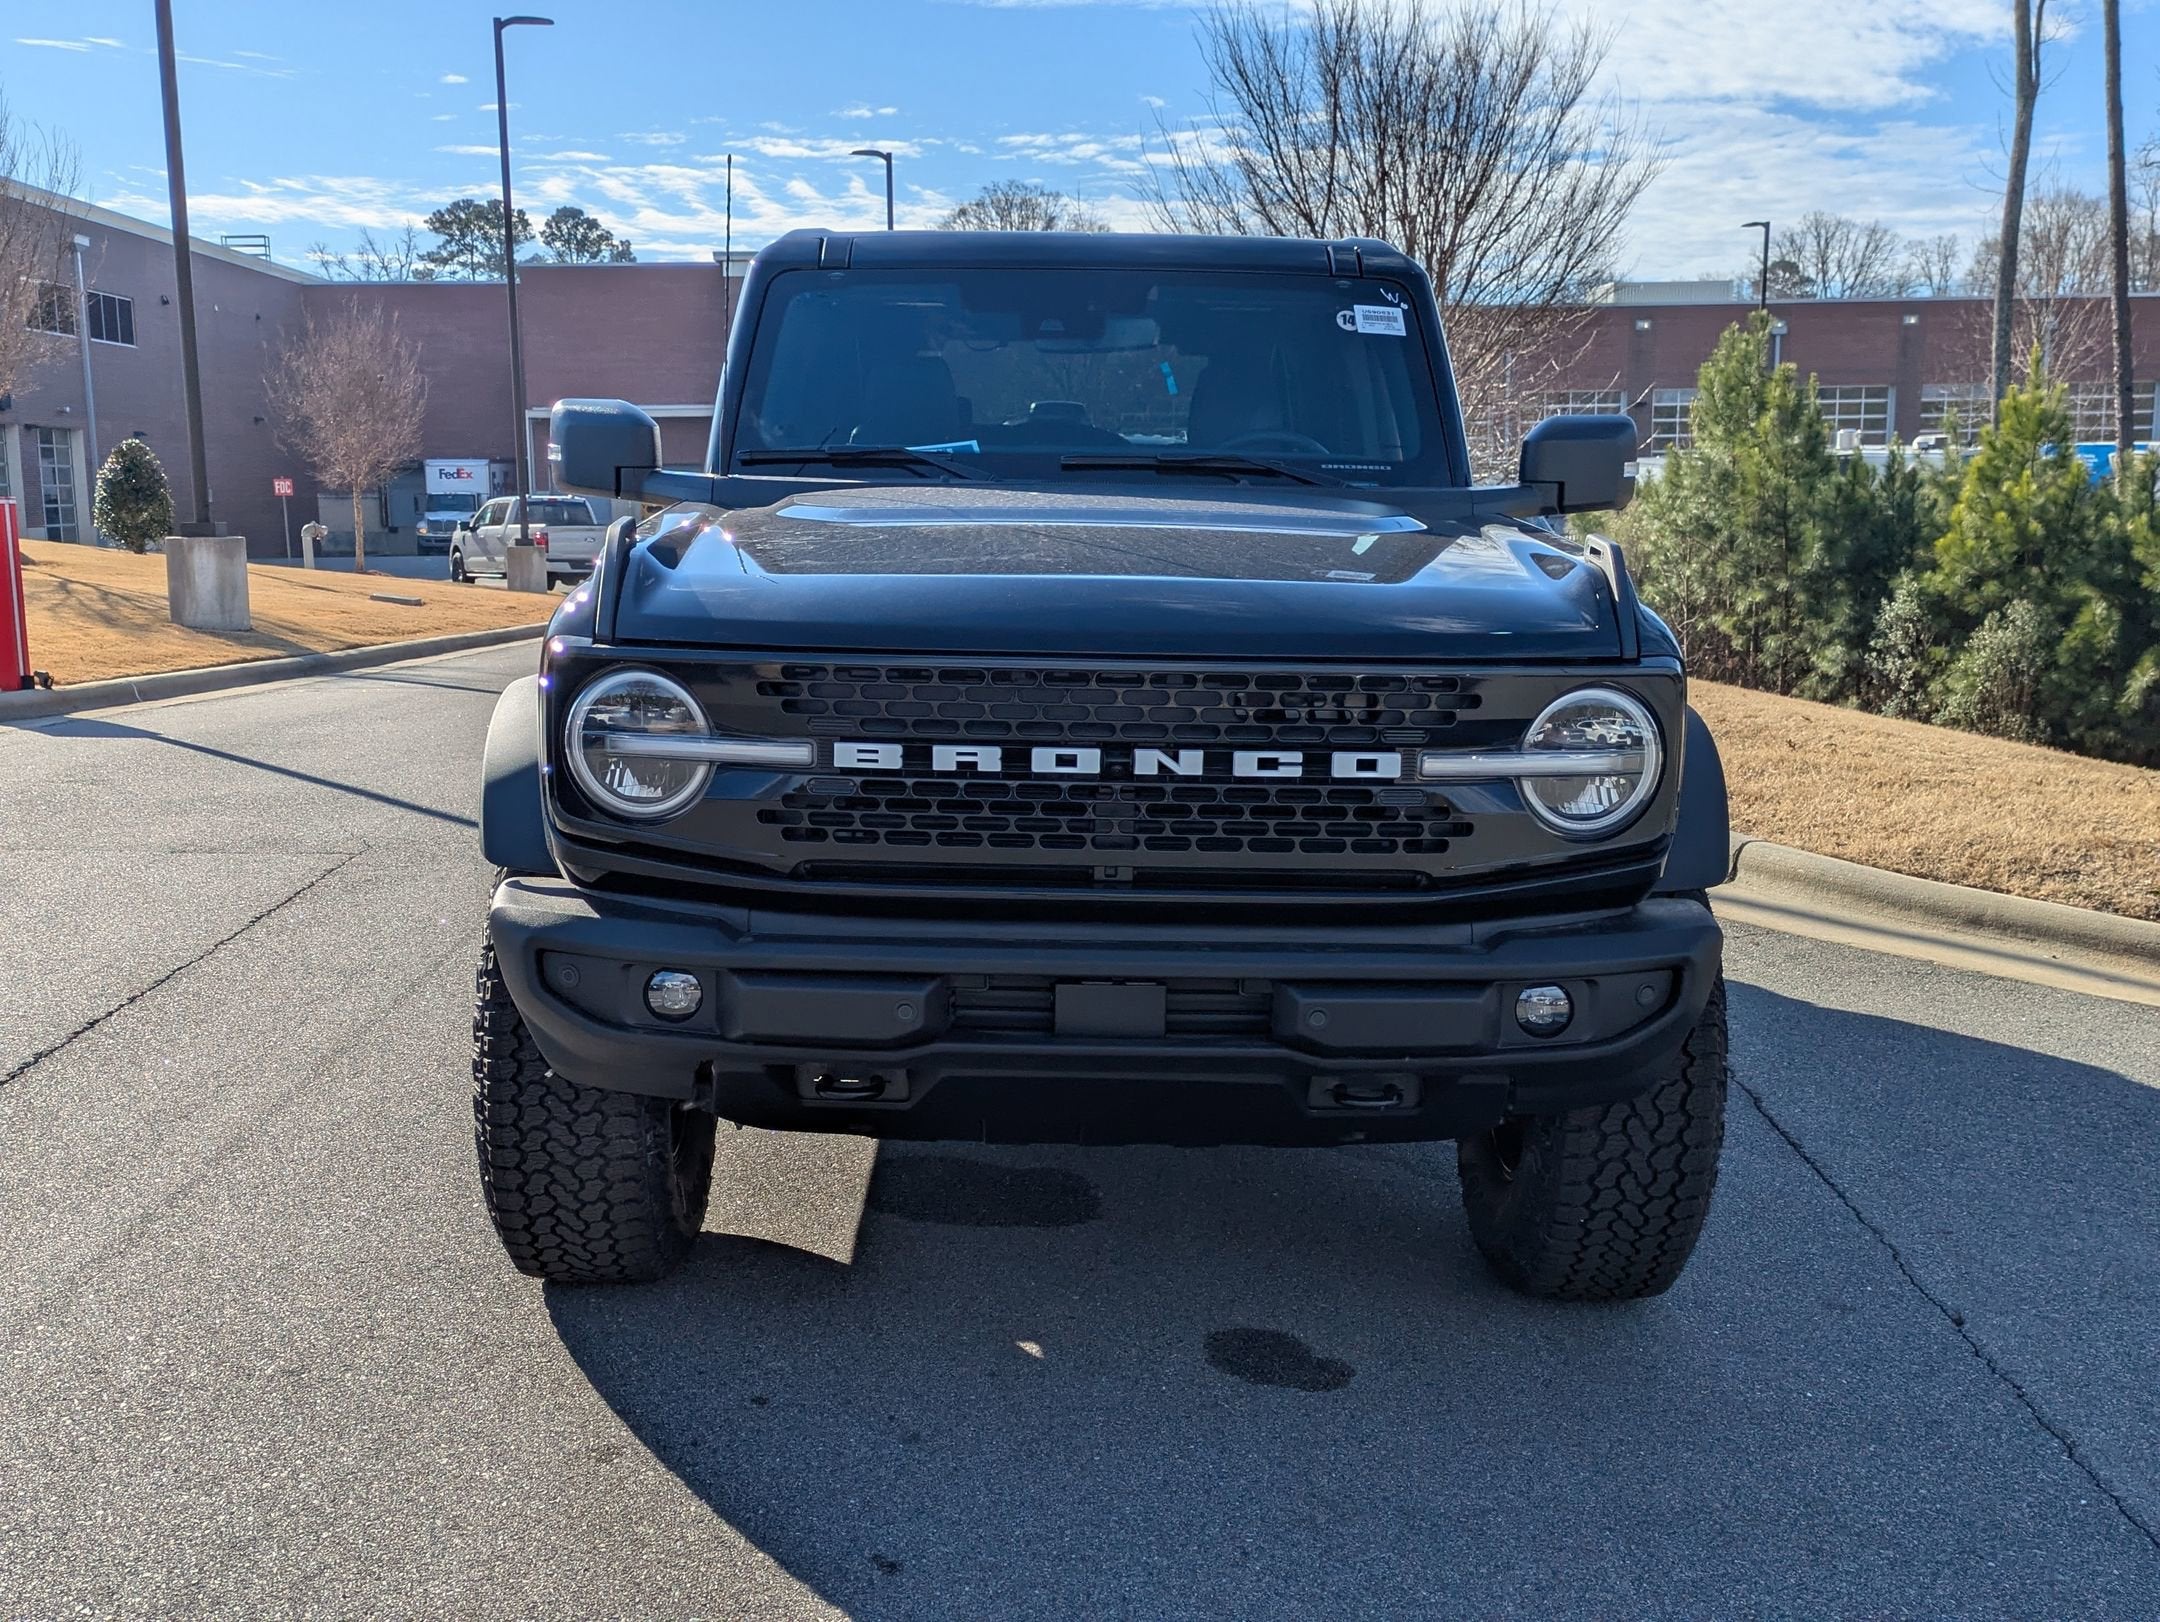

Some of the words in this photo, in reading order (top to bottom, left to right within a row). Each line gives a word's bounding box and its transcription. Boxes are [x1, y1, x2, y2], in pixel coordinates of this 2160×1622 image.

[439, 468, 473, 480] FedEx
[274, 480, 292, 494] FDC
[833, 742, 1402, 778] BRONCO
